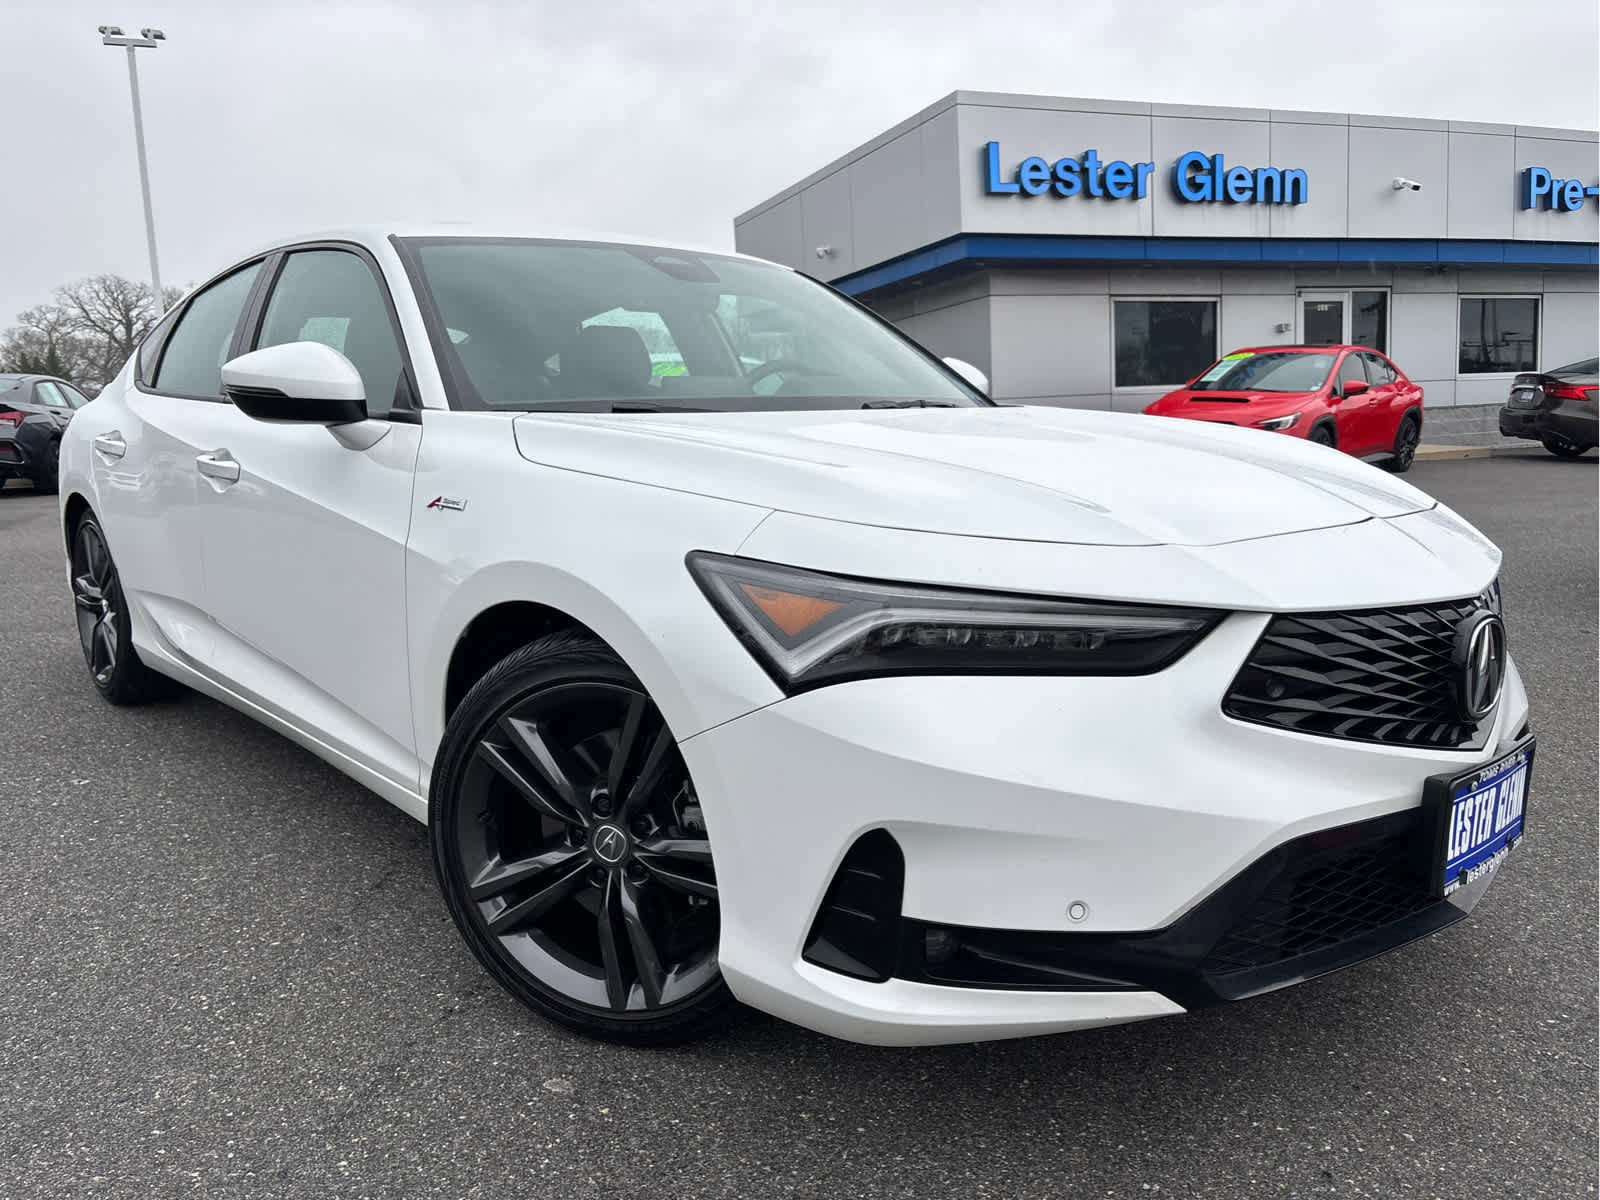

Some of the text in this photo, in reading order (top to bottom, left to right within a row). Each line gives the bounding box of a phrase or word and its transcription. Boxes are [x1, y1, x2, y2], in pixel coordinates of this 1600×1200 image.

[985, 141, 1308, 204] Lester Glenn
[1447, 765, 1527, 861] LESTER GLENN
